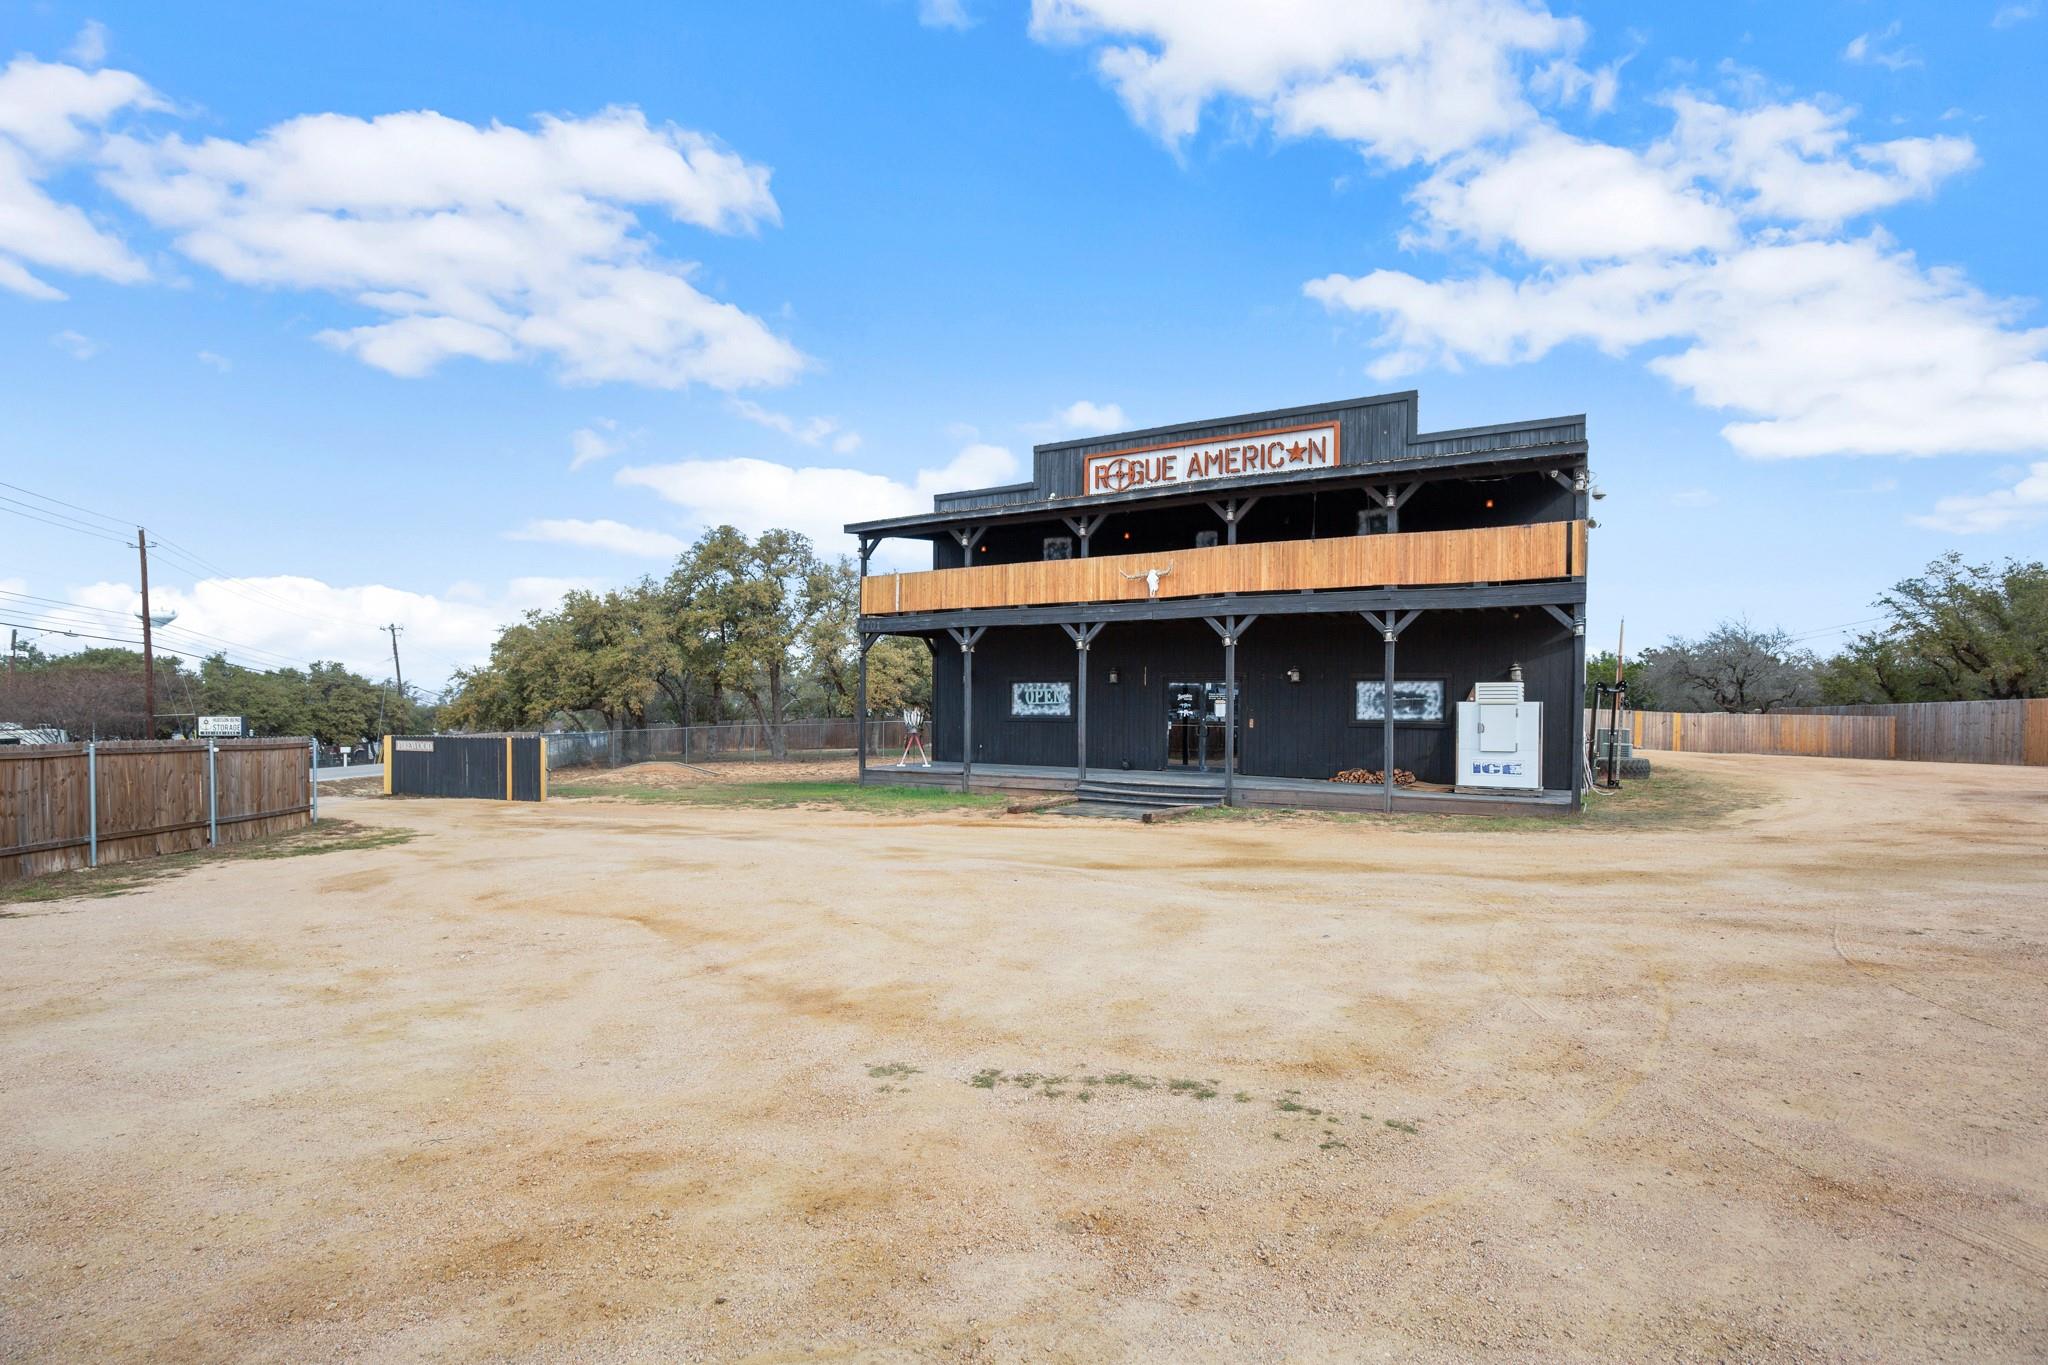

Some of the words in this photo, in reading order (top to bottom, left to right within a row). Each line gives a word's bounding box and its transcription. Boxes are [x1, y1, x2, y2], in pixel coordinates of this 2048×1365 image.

[1094, 455, 1177, 492] ROGUE
[1024, 688, 1062, 705] OPEN
[212, 723, 241, 731] STORAGE
[1472, 762, 1522, 775] ICE
